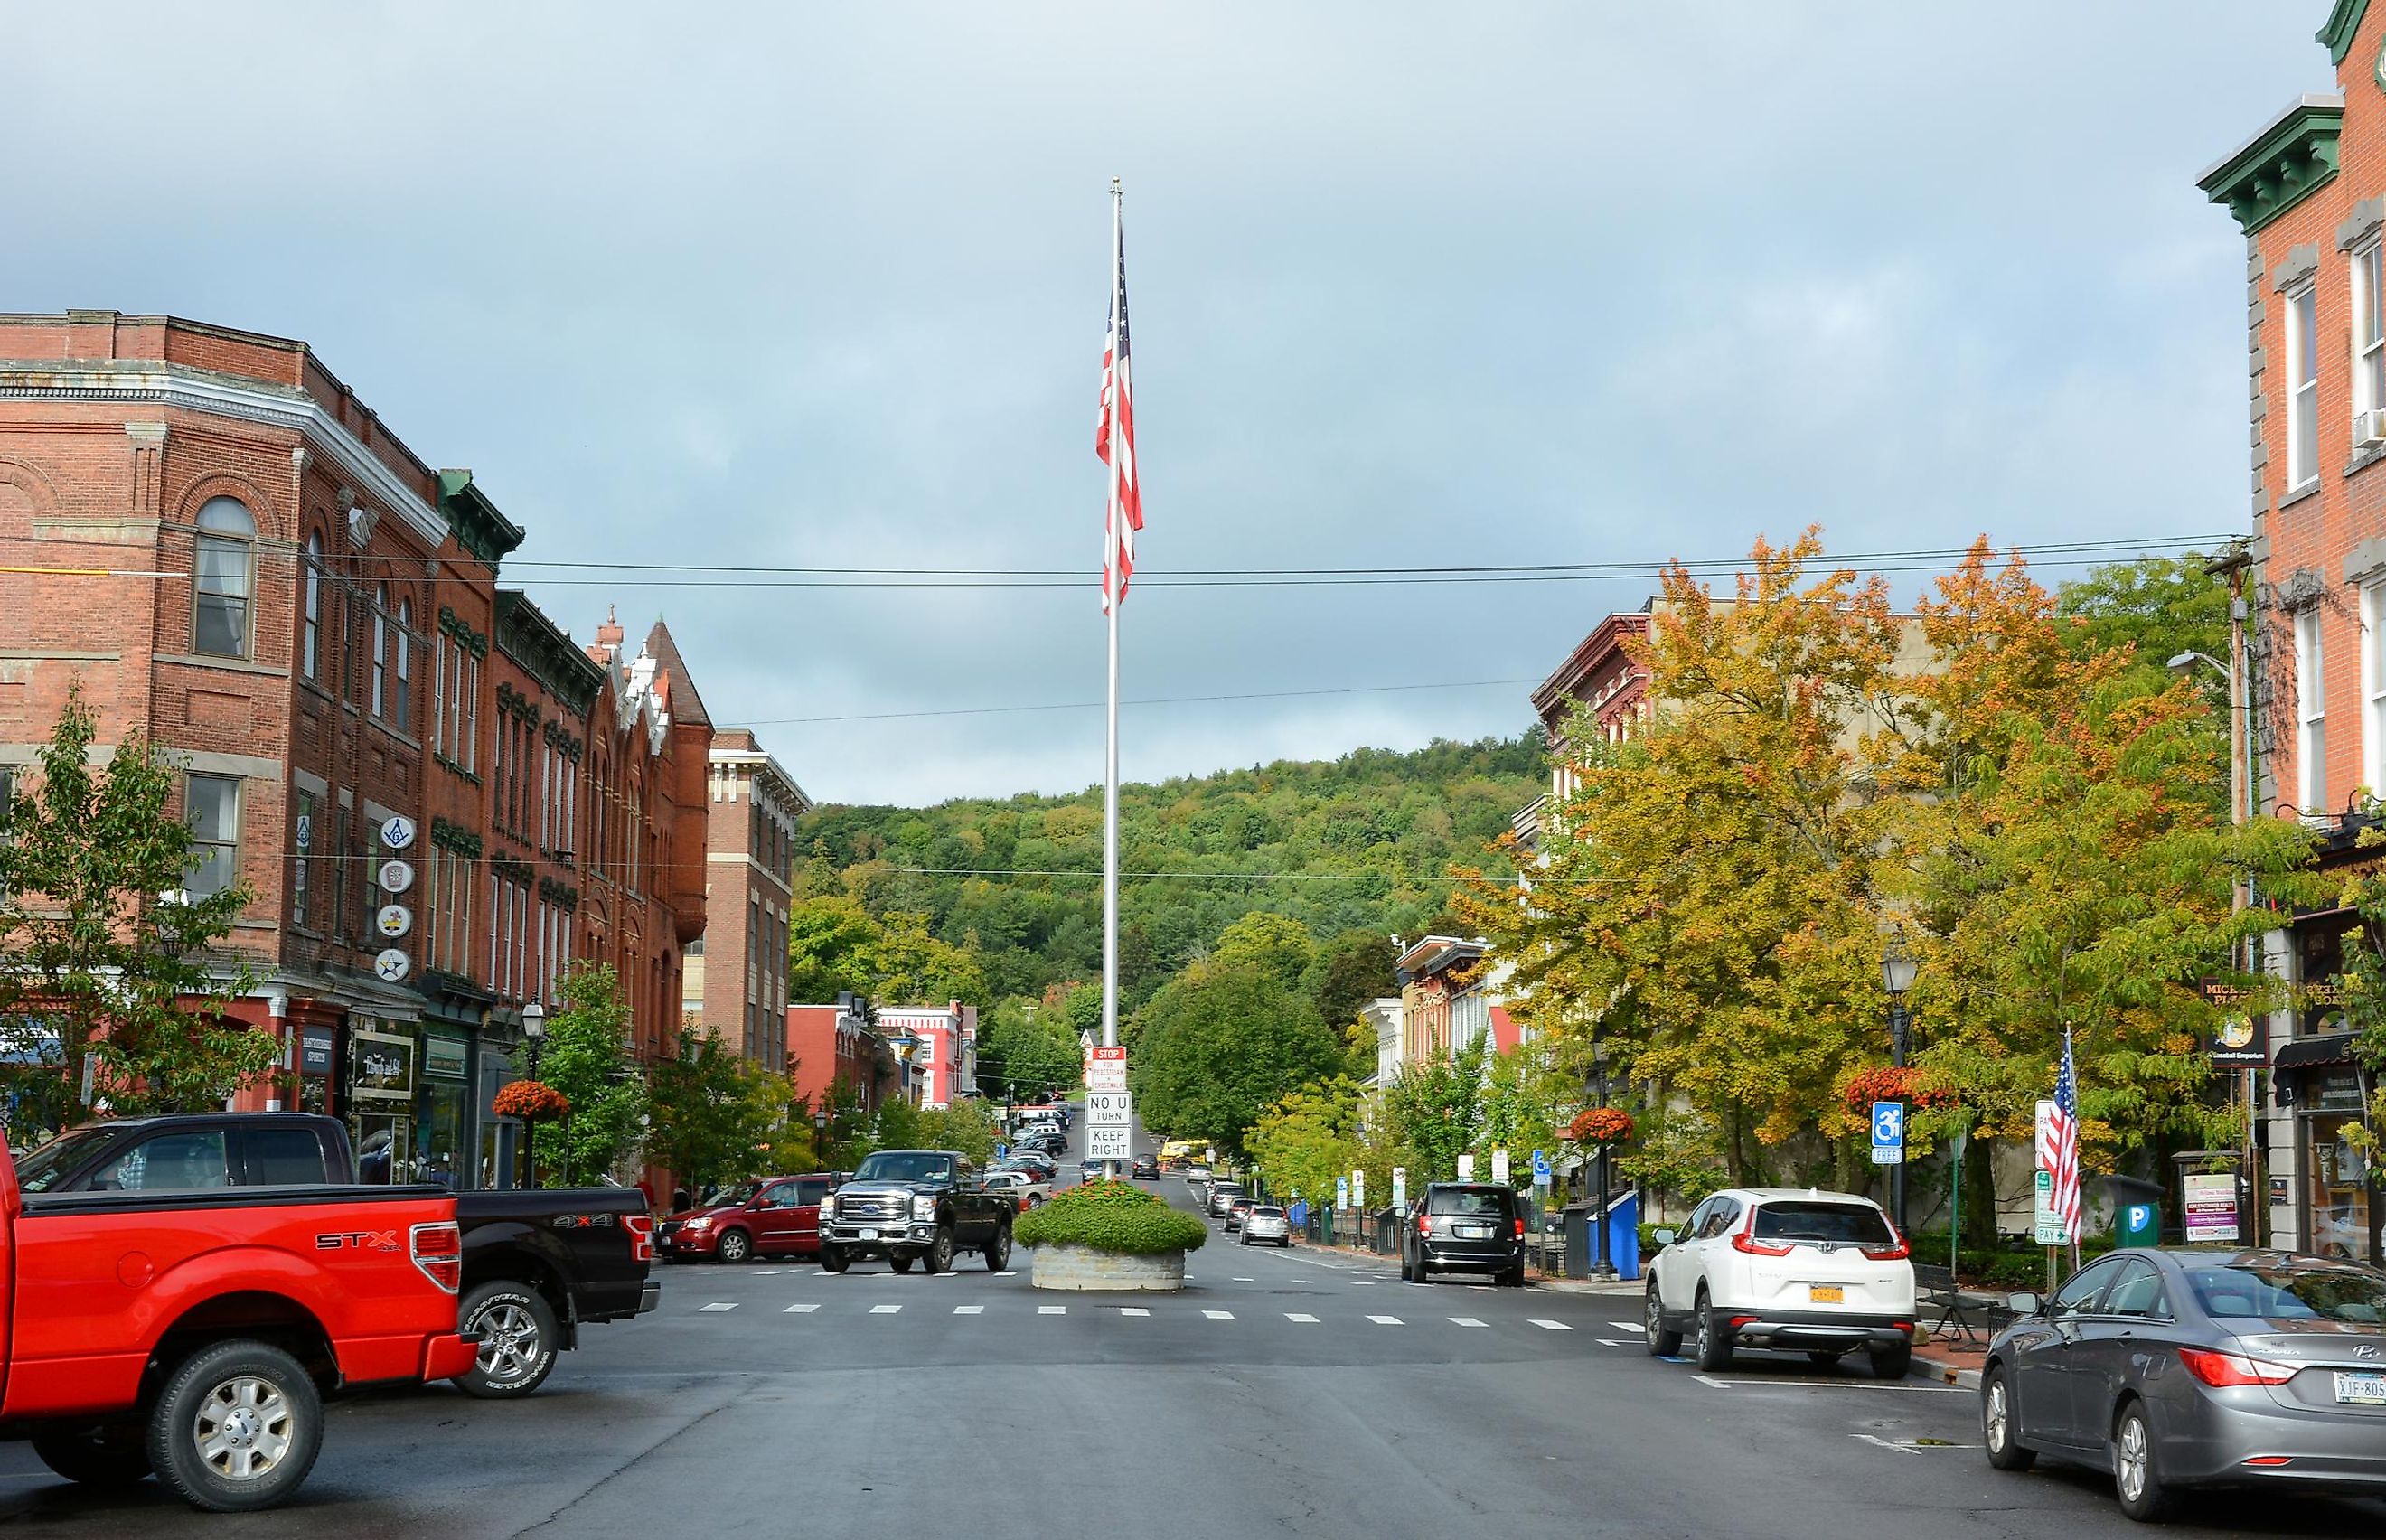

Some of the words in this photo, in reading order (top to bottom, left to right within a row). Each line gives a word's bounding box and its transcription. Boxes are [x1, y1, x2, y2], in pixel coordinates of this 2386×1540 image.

[1097, 1049, 1119, 1058] STOP
[2237, 1051, 2265, 1060] Emporium
[1090, 1097, 1110, 1109] NO
[1118, 1097, 1127, 1109] U
[1096, 1113, 1122, 1121] TURN
[1094, 1131, 1124, 1141] KEEP
[1091, 1145, 1127, 1155] RIGHT
[1875, 1150, 1899, 1162] FREE
[2131, 1207, 2145, 1227] P
[315, 1230, 398, 1249] STX
[2039, 1229, 2053, 1242] PAY
[464, 1293, 530, 1331] GOODYEAR
